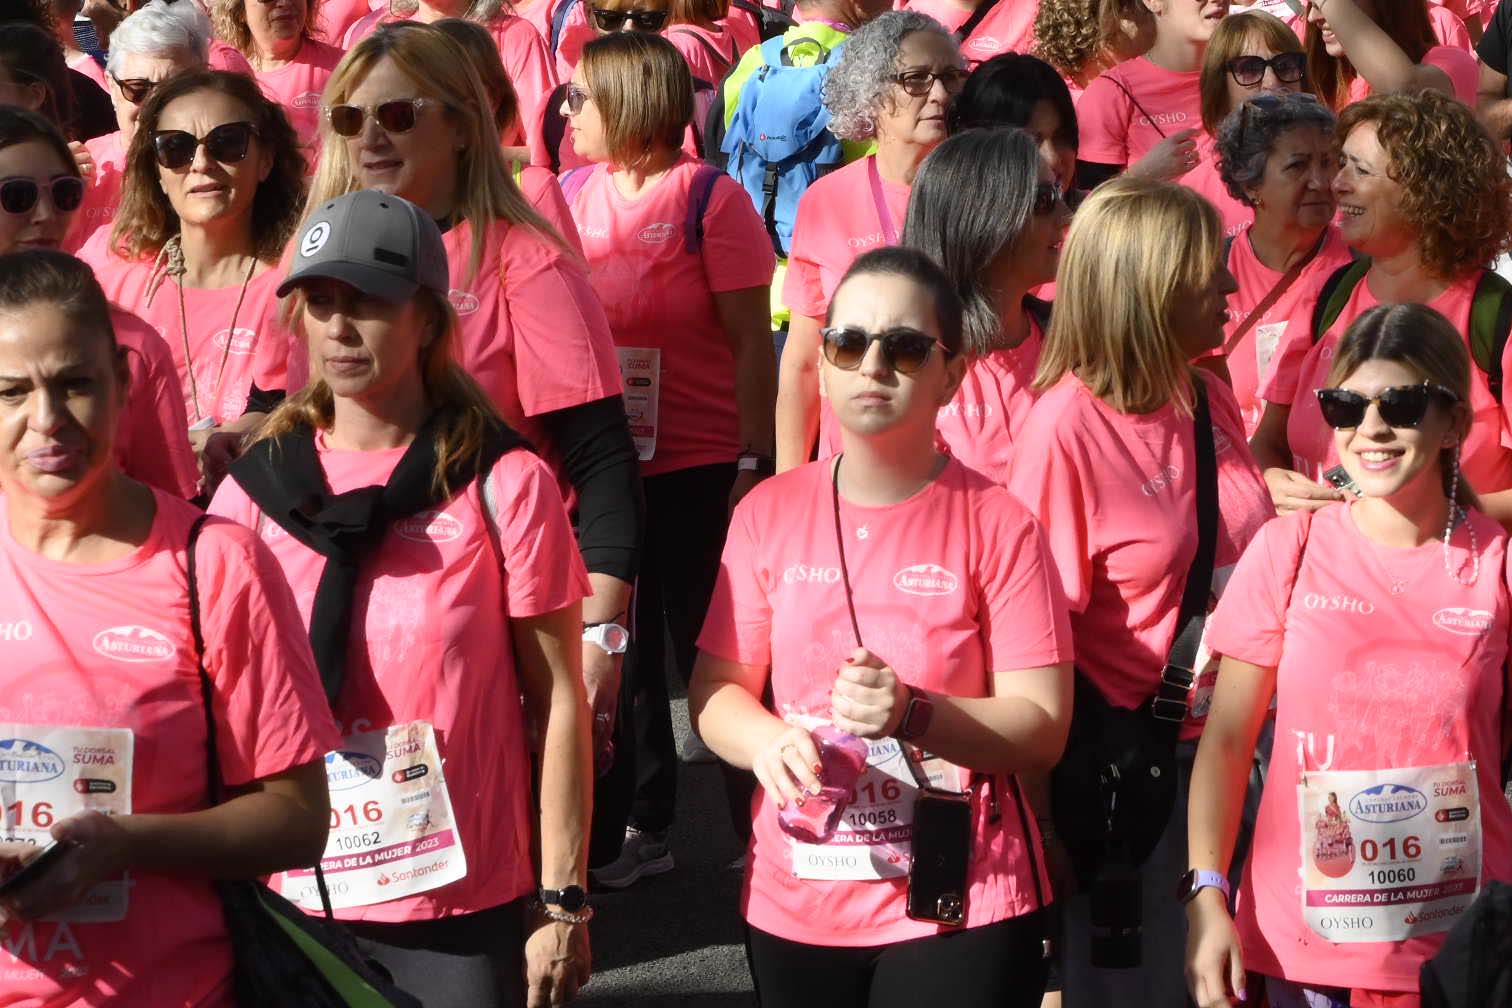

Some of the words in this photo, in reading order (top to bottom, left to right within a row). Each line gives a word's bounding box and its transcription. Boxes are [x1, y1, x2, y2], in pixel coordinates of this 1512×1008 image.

[1304, 593, 1375, 615] OYSHO
[101, 636, 171, 657] ASTURIANA
[386, 744, 424, 761] SUMA
[1291, 728, 1335, 772] TU
[0, 757, 59, 775] TURIANA
[73, 753, 116, 767] SUMA
[328, 765, 376, 784] TURIANA
[1433, 786, 1468, 798] SUMA
[0, 801, 55, 829] 16
[329, 800, 383, 829] 016
[1354, 798, 1422, 816] ASTURIANA
[849, 809, 898, 826] 10058
[335, 831, 382, 851] 10062
[1359, 834, 1423, 864] 016
[374, 845, 412, 864] MUJER
[415, 837, 441, 853] 2023
[808, 854, 858, 868] OYSHO
[391, 859, 450, 883] Santander
[1367, 867, 1416, 885] 10060
[1325, 893, 1372, 905] CARRERA
[1373, 892, 1389, 903] DE
[1390, 892, 1405, 902] LA
[1320, 916, 1374, 930] OYSHO
[1417, 905, 1466, 923] Santander
